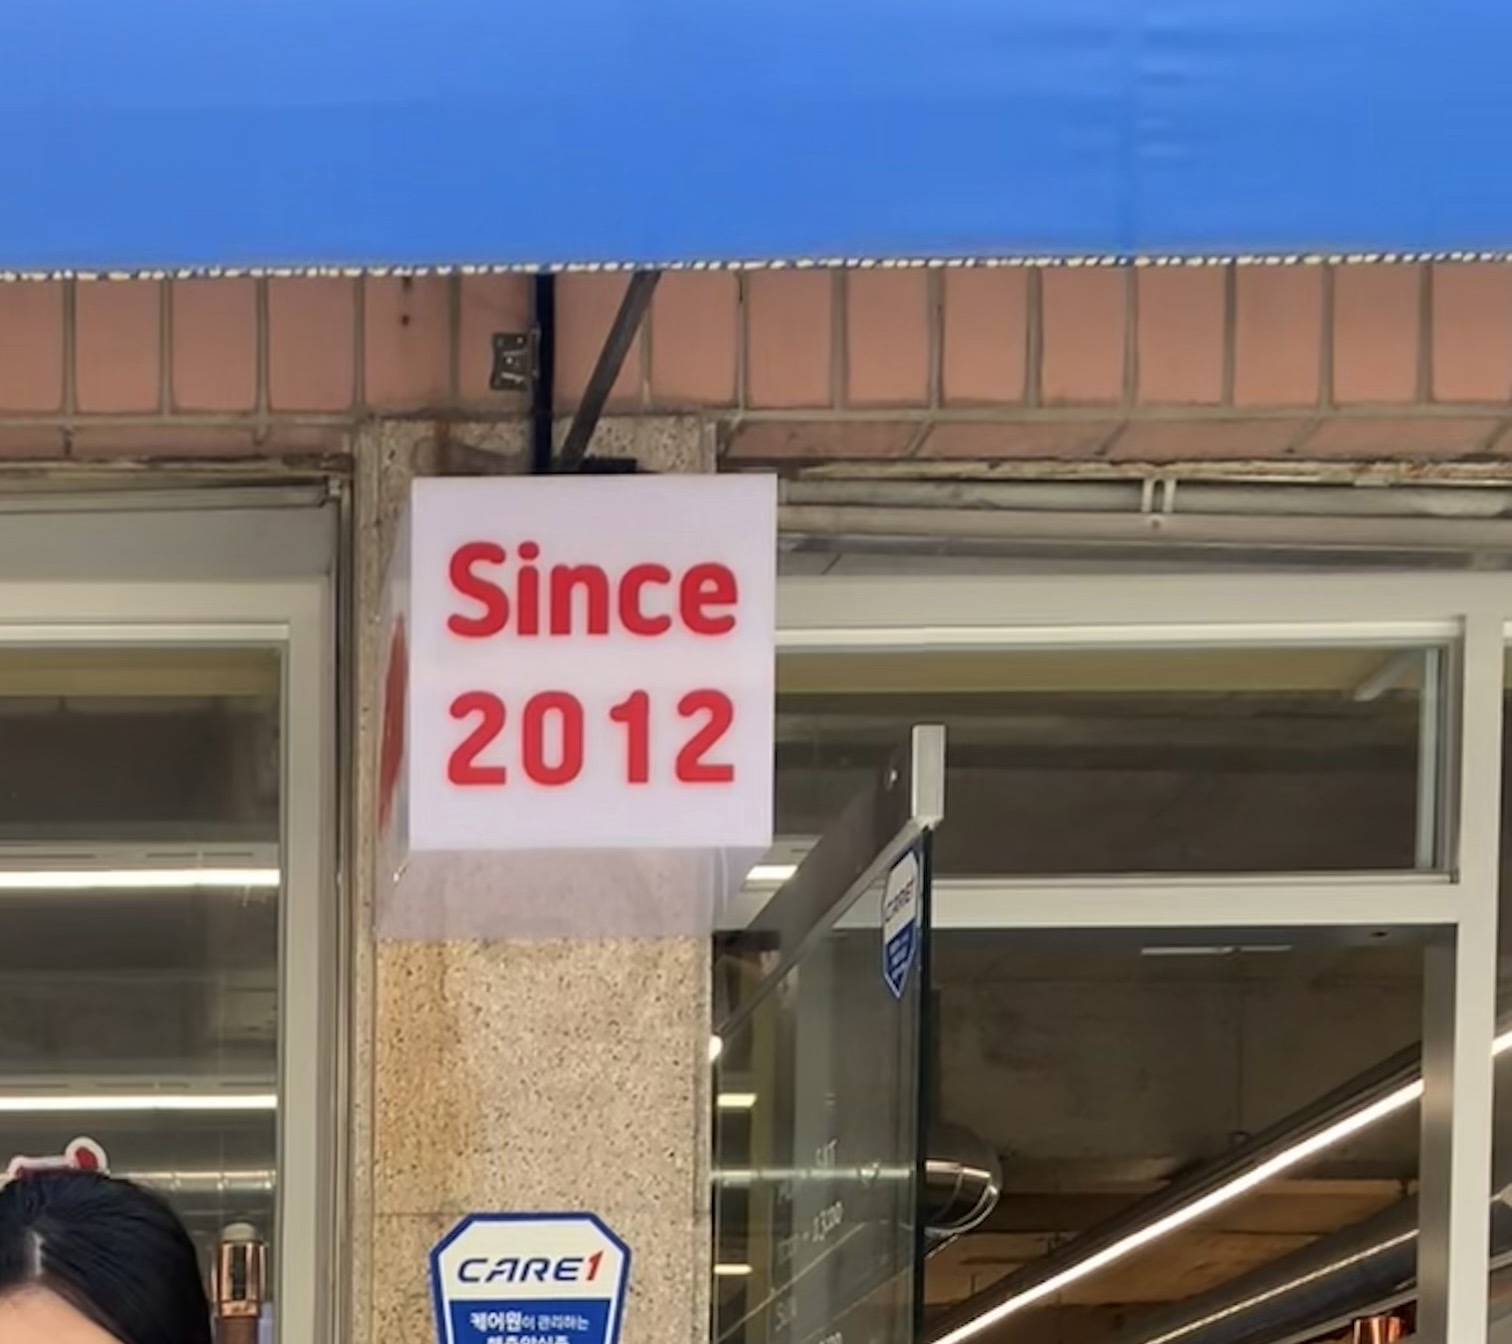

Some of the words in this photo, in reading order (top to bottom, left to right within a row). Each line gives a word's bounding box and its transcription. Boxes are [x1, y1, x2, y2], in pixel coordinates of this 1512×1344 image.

[447, 540, 739, 639] Since
[447, 689, 735, 786] 2012
[457, 1250, 604, 1284] CARE1
